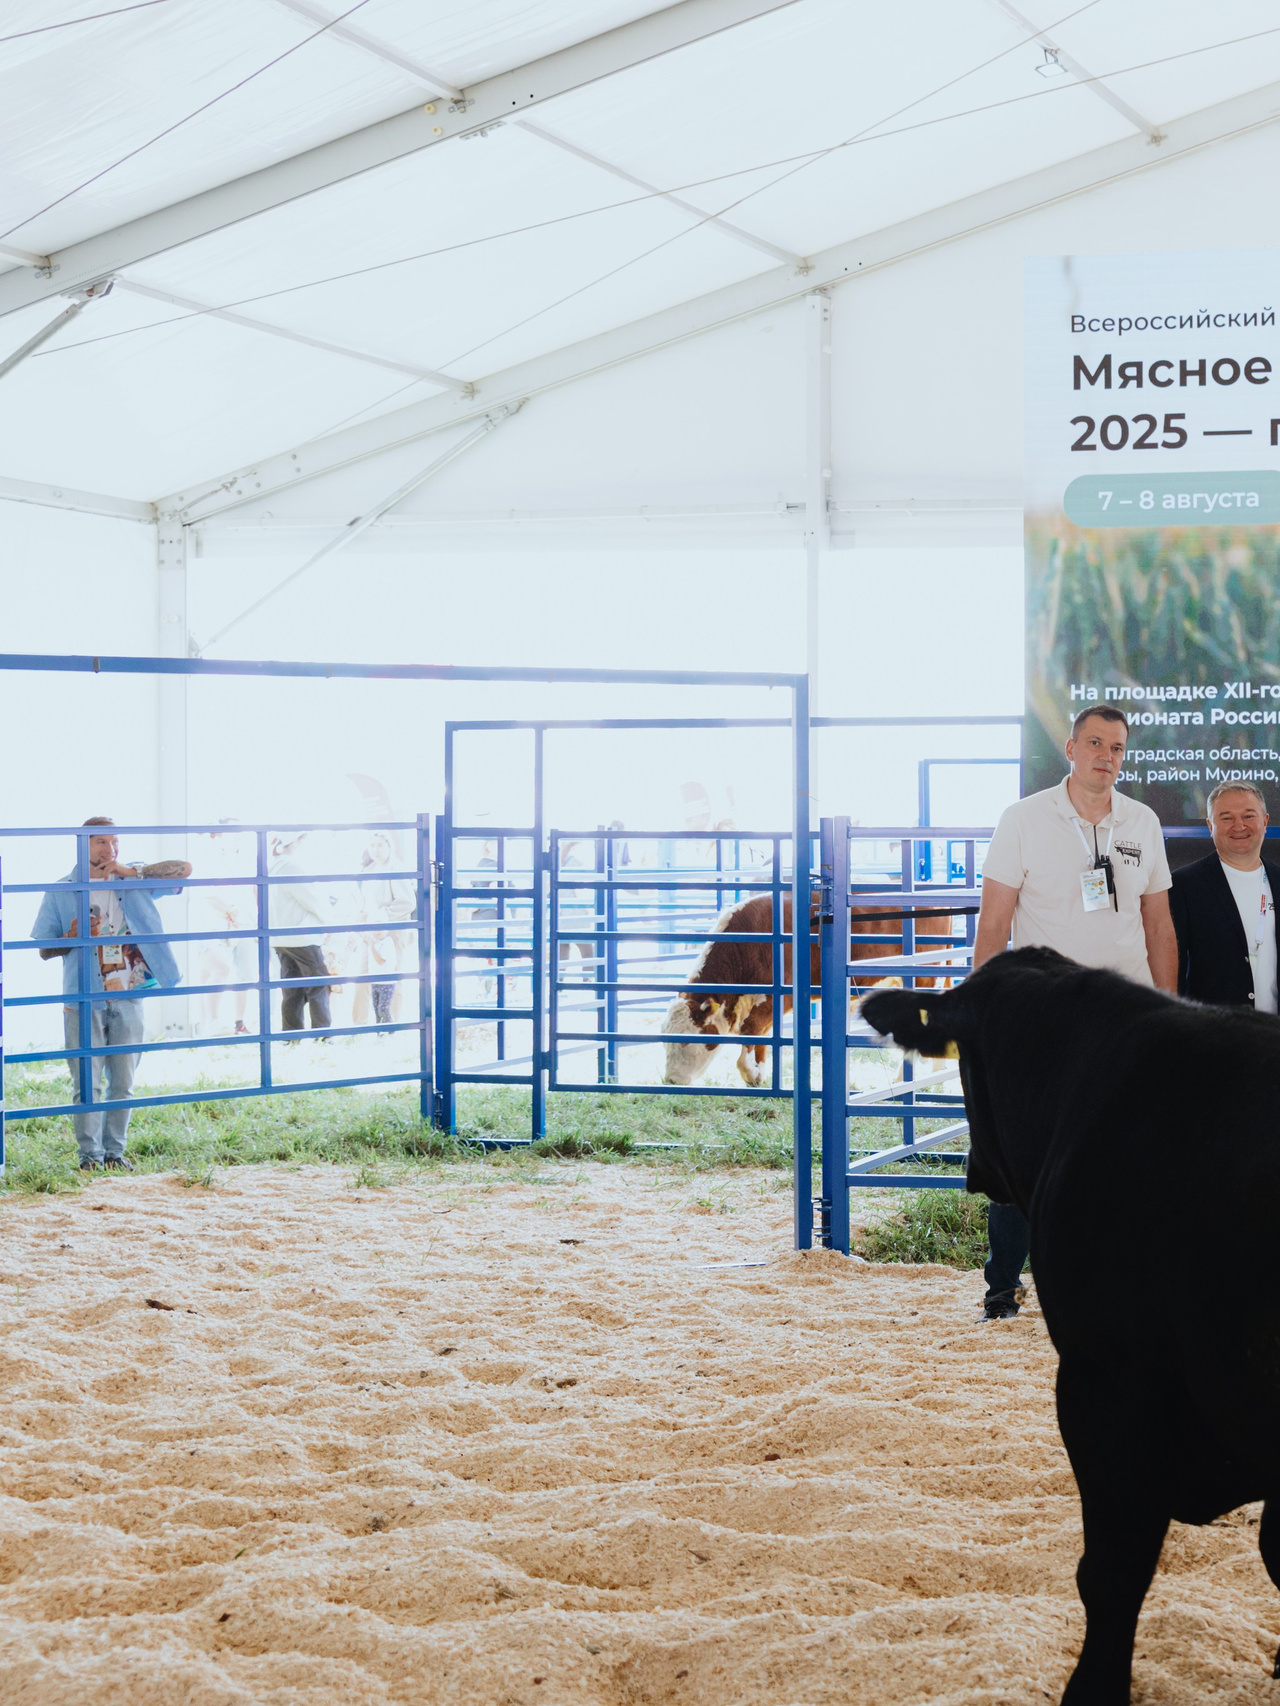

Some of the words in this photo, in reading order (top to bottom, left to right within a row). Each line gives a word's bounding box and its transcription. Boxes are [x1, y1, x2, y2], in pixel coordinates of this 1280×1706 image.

[1070, 306, 1276, 335] Всероссийский
[1072, 353, 1273, 391] Мясное
[1069, 412, 1188, 452] 2025
[1098, 491, 1113, 511] 7
[1139, 489, 1155, 510] 8
[1161, 489, 1261, 514] августа
[1070, 684, 1099, 701] На
[1104, 684, 1218, 702] площадке
[1122, 749, 1204, 764] градская
[1146, 767, 1200, 784] район
[1205, 767, 1279, 783] Мурино,
[1114, 840, 1142, 849] CATTLE
